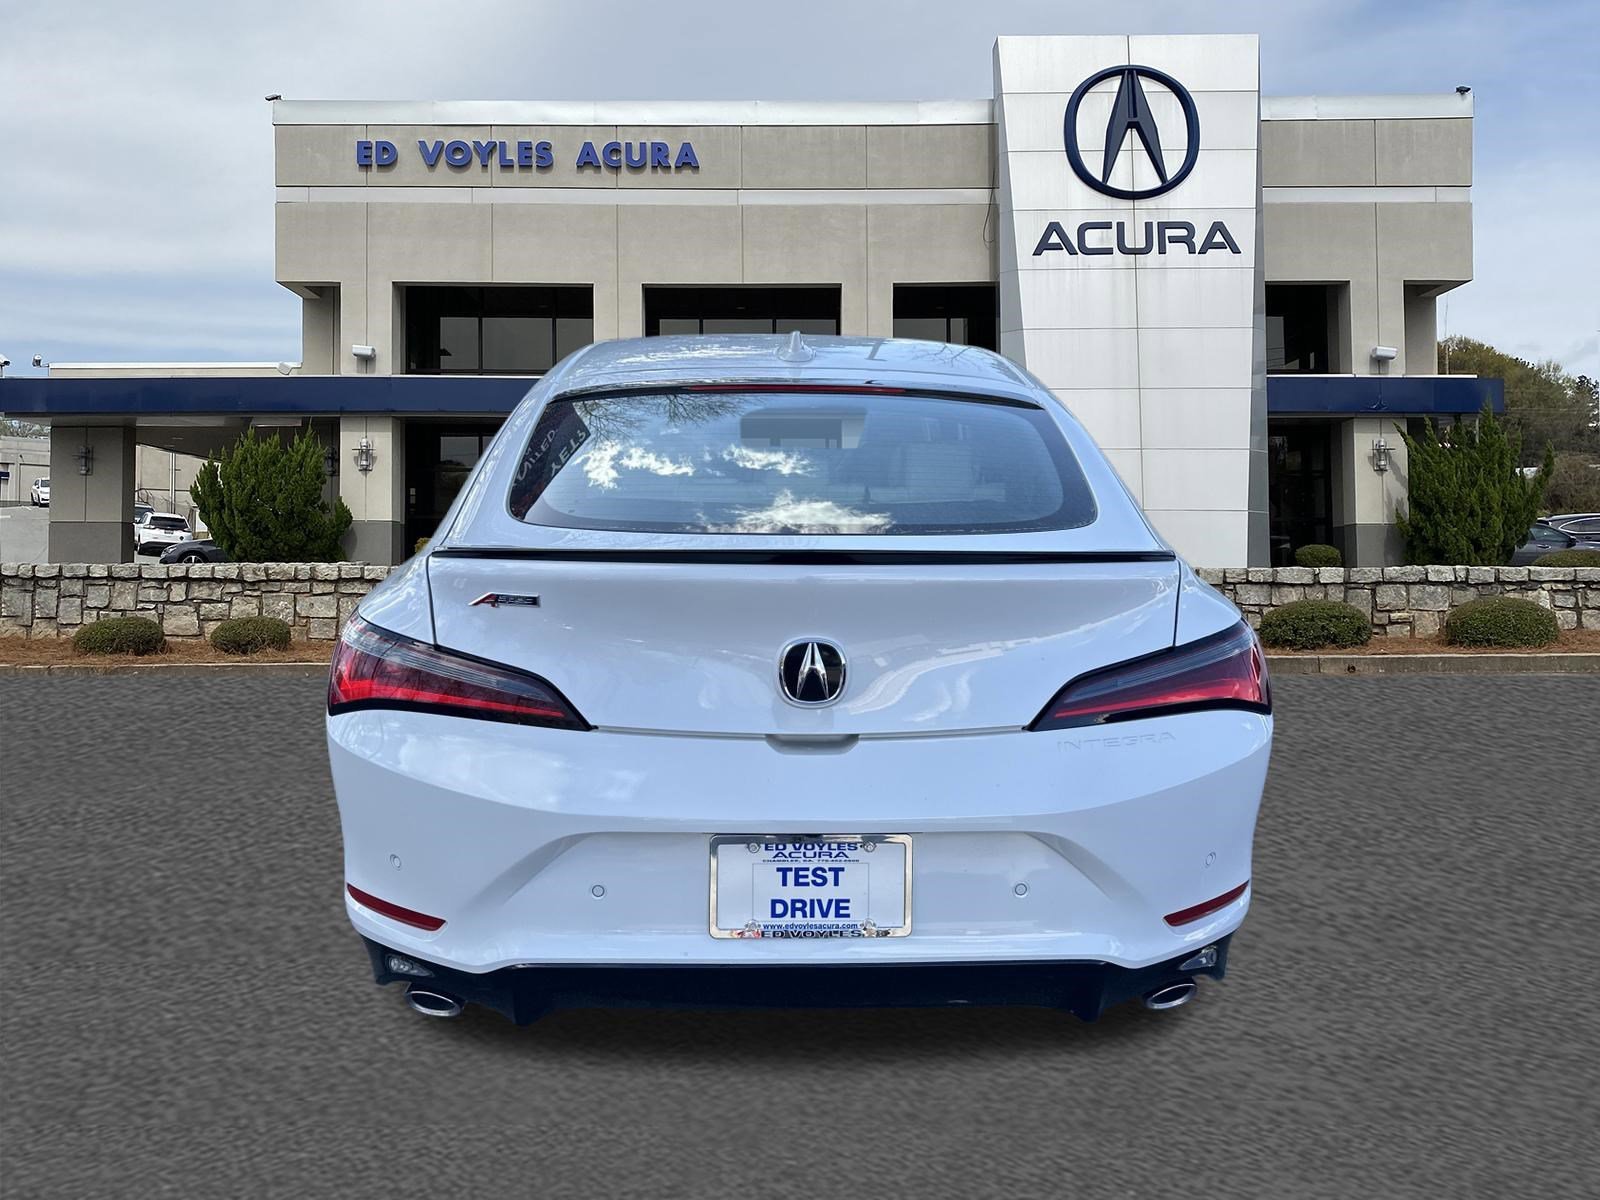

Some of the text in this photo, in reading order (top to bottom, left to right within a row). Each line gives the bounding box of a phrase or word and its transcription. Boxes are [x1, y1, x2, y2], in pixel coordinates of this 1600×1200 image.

[356, 140, 700, 168] ED VOYLES ACURA
[1032, 221, 1242, 256] ACURA
[1057, 731, 1177, 753] INTEGRA
[764, 842, 858, 851] ED VOYLES
[772, 851, 849, 859] ACURA
[776, 866, 845, 887] TEST
[770, 898, 851, 919] DRIVE
[763, 922, 859, 931] www.edvoylesacura.com
[789, 930, 862, 938] VOYLES
